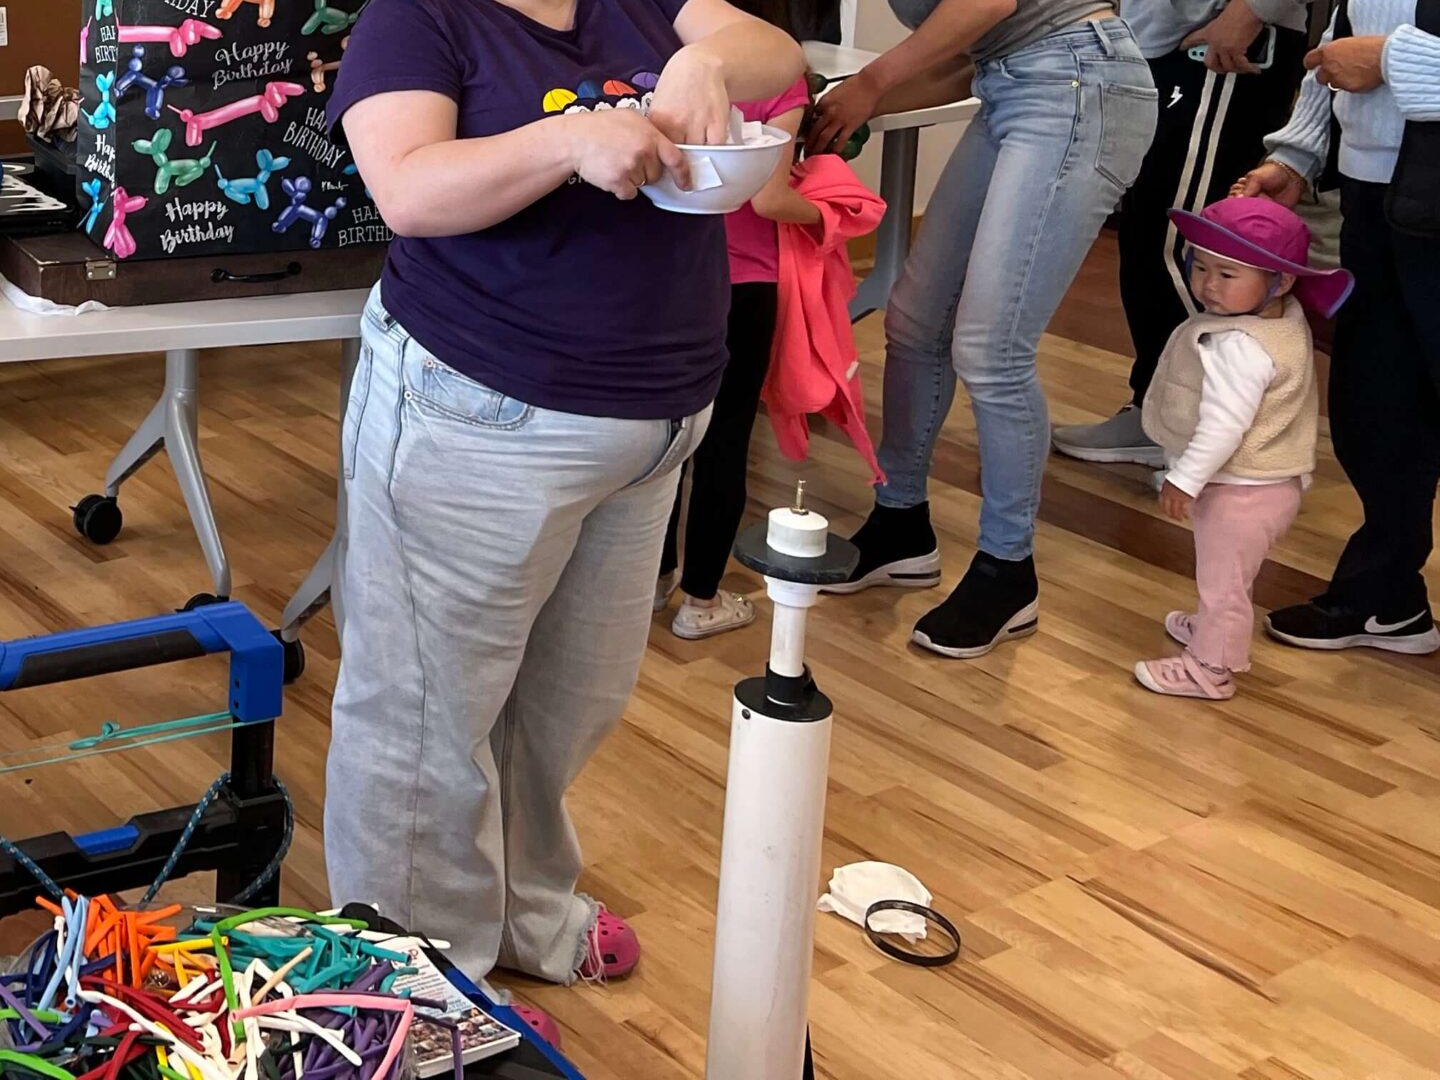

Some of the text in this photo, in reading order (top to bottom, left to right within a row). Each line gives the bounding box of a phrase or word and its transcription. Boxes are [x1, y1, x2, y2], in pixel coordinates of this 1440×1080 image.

[214, 41, 290, 66] Happy
[212, 58, 293, 91] Birthday
[283, 121, 346, 169] BIRTHDAY
[165, 196, 230, 223] Happy
[160, 221, 235, 254] Birthday
